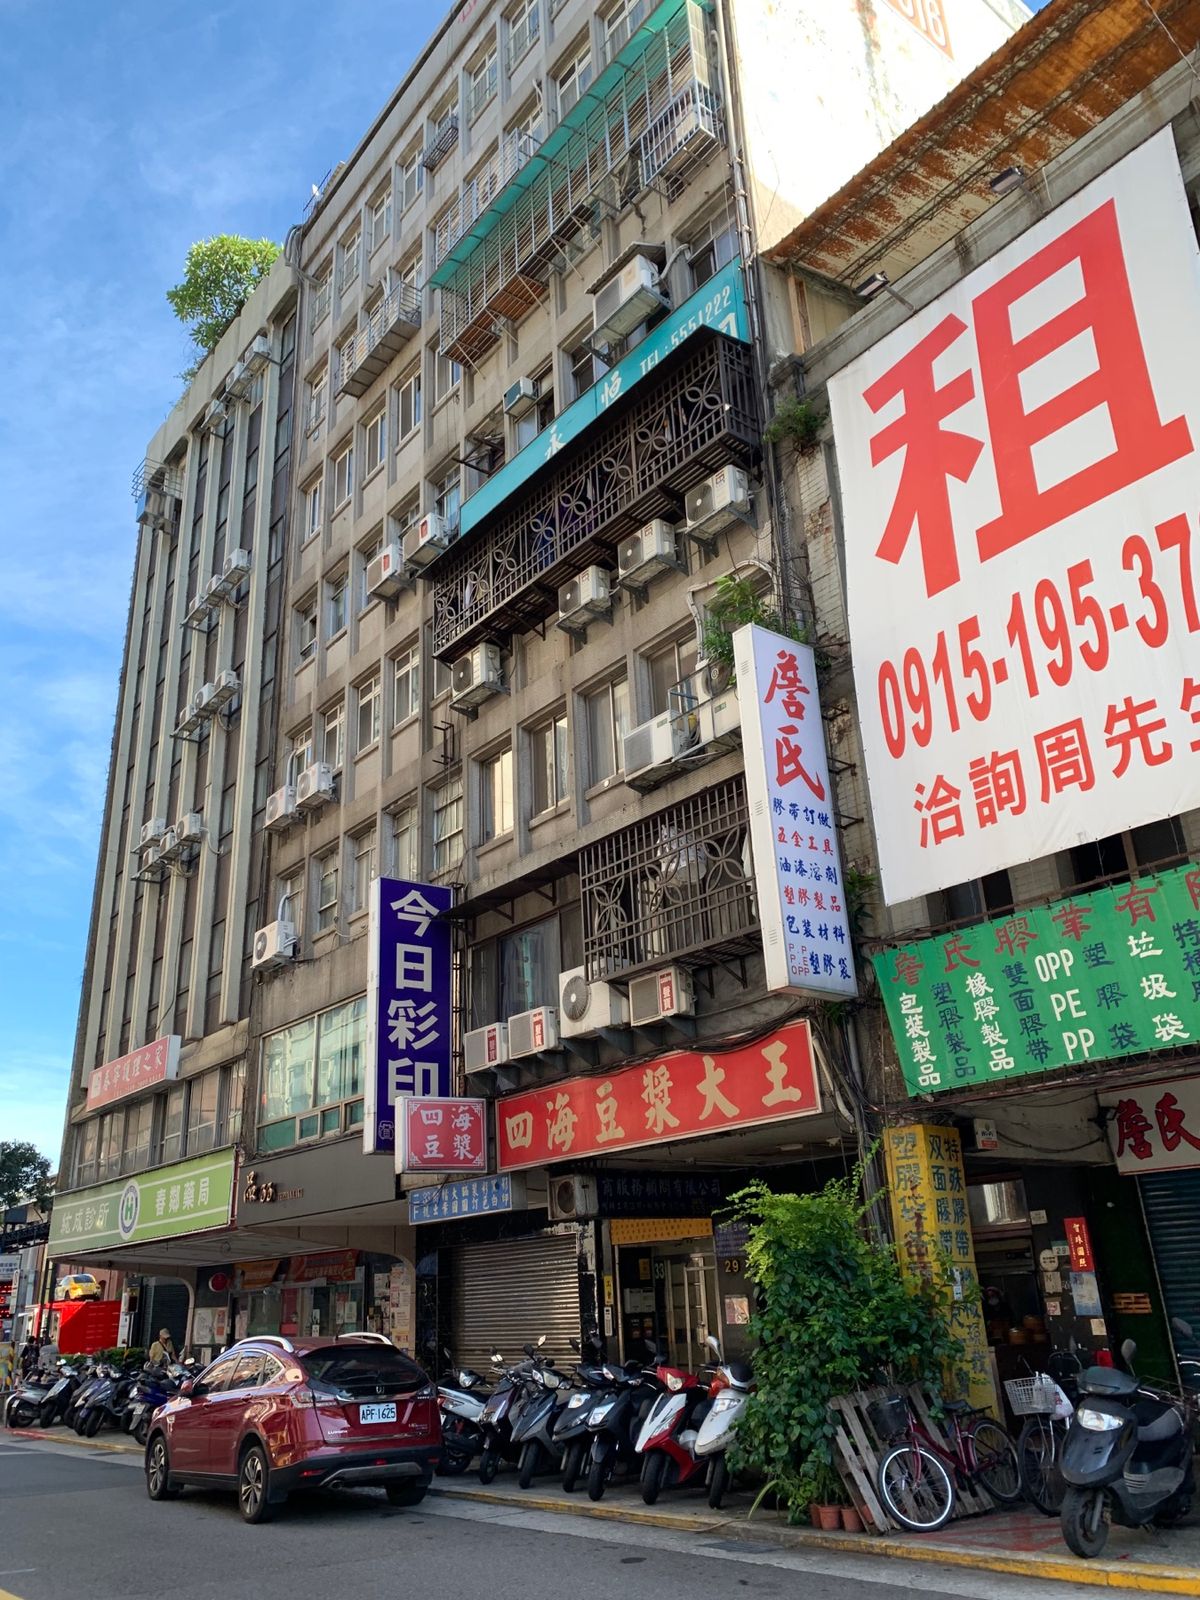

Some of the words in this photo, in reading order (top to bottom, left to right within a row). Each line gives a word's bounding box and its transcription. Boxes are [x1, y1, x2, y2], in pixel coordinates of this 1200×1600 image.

[862, 197, 1195, 598] 租
[877, 512, 1200, 760] 0915-195-37
[764, 650, 826, 802] 詹氏
[773, 797, 832, 829] 膠帶訂做
[777, 827, 834, 857] 五金工具
[779, 857, 838, 886] 油漆溶劑
[784, 885, 842, 913] 塑膠製品
[786, 915, 846, 945] 包裝材料
[809, 951, 851, 980] 塑膠袋
[1034, 948, 1074, 983] OPP
[1127, 930, 1191, 1042] 垃圾袋
[388, 889, 440, 1107] 今日彩印
[1001, 961, 1054, 1065] 雙面膠帶
[1050, 988, 1087, 1022] PE
[1082, 941, 1142, 1051] 塑膠袋
[899, 992, 942, 1087] 包裝製品
[930, 981, 977, 1079] 塑膠製品
[965, 972, 1016, 1072] 橡膠製品
[1062, 1028, 1095, 1061] PP
[420, 1106, 475, 1131] 四海
[505, 1040, 802, 1152] 四海豆漿大王
[422, 1133, 476, 1161] 豆漿
[1116, 1092, 1200, 1160] 詹氏
[725, 1260, 740, 1273] 29
